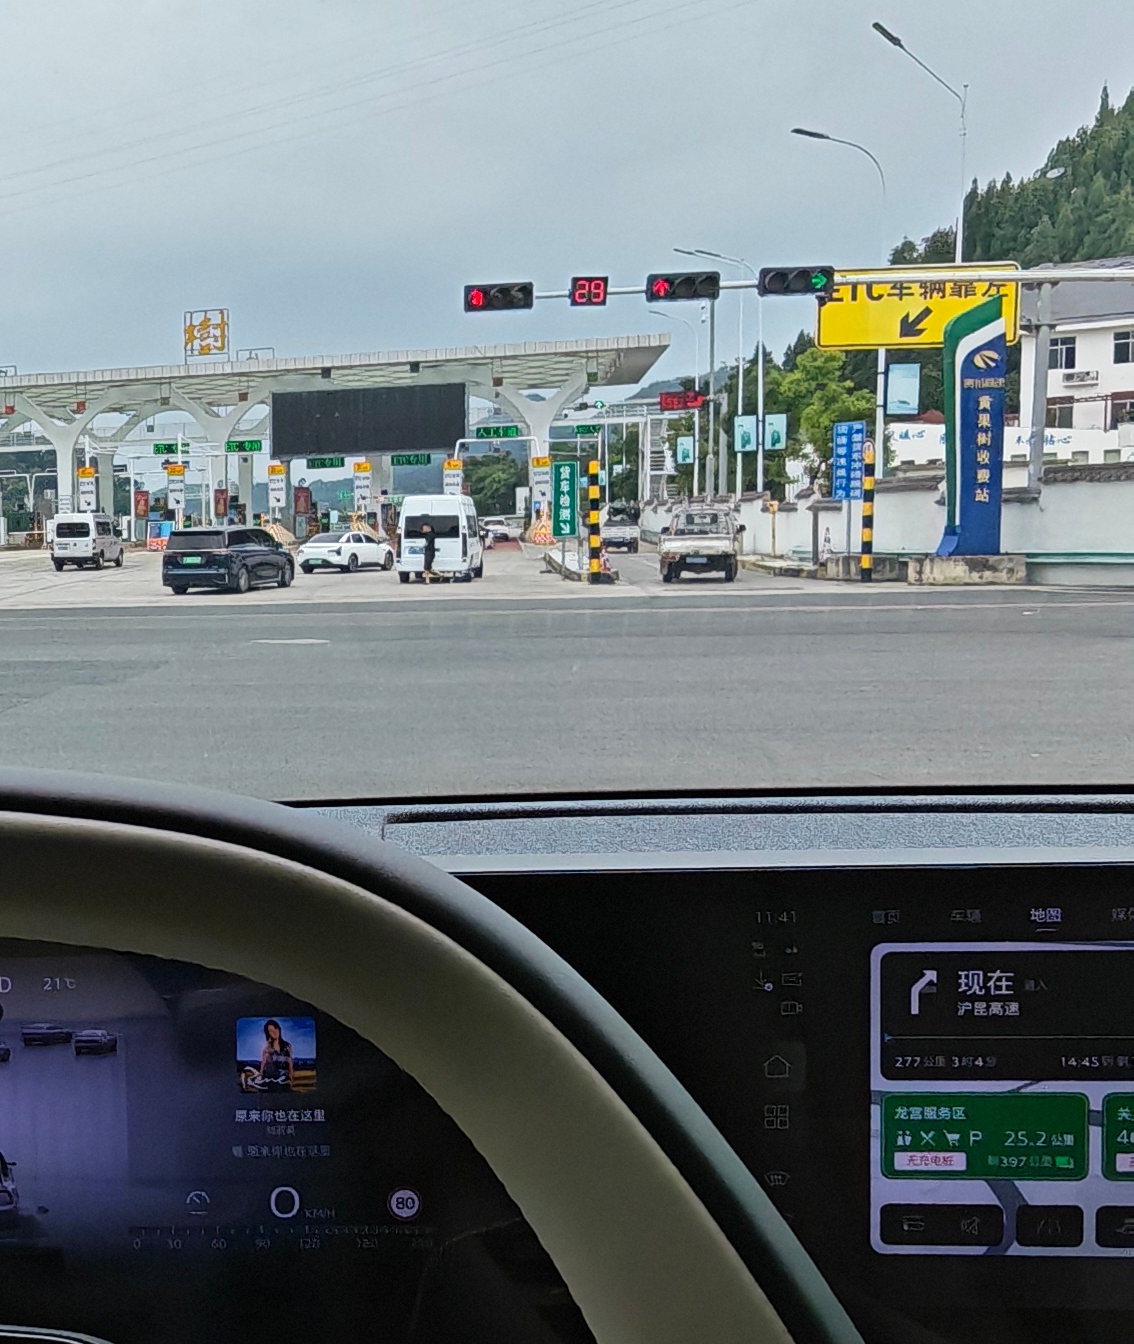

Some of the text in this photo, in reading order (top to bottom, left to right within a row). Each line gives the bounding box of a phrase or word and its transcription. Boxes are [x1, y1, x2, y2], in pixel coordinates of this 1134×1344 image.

[575, 280, 605, 303] 29
[1030, 908, 1062, 923] 地图
[957, 970, 1015, 996] 现在
[957, 1002, 1020, 1016] 沪昆高速
[268, 1185, 301, 1219] 0
[395, 1197, 415, 1210] 80
